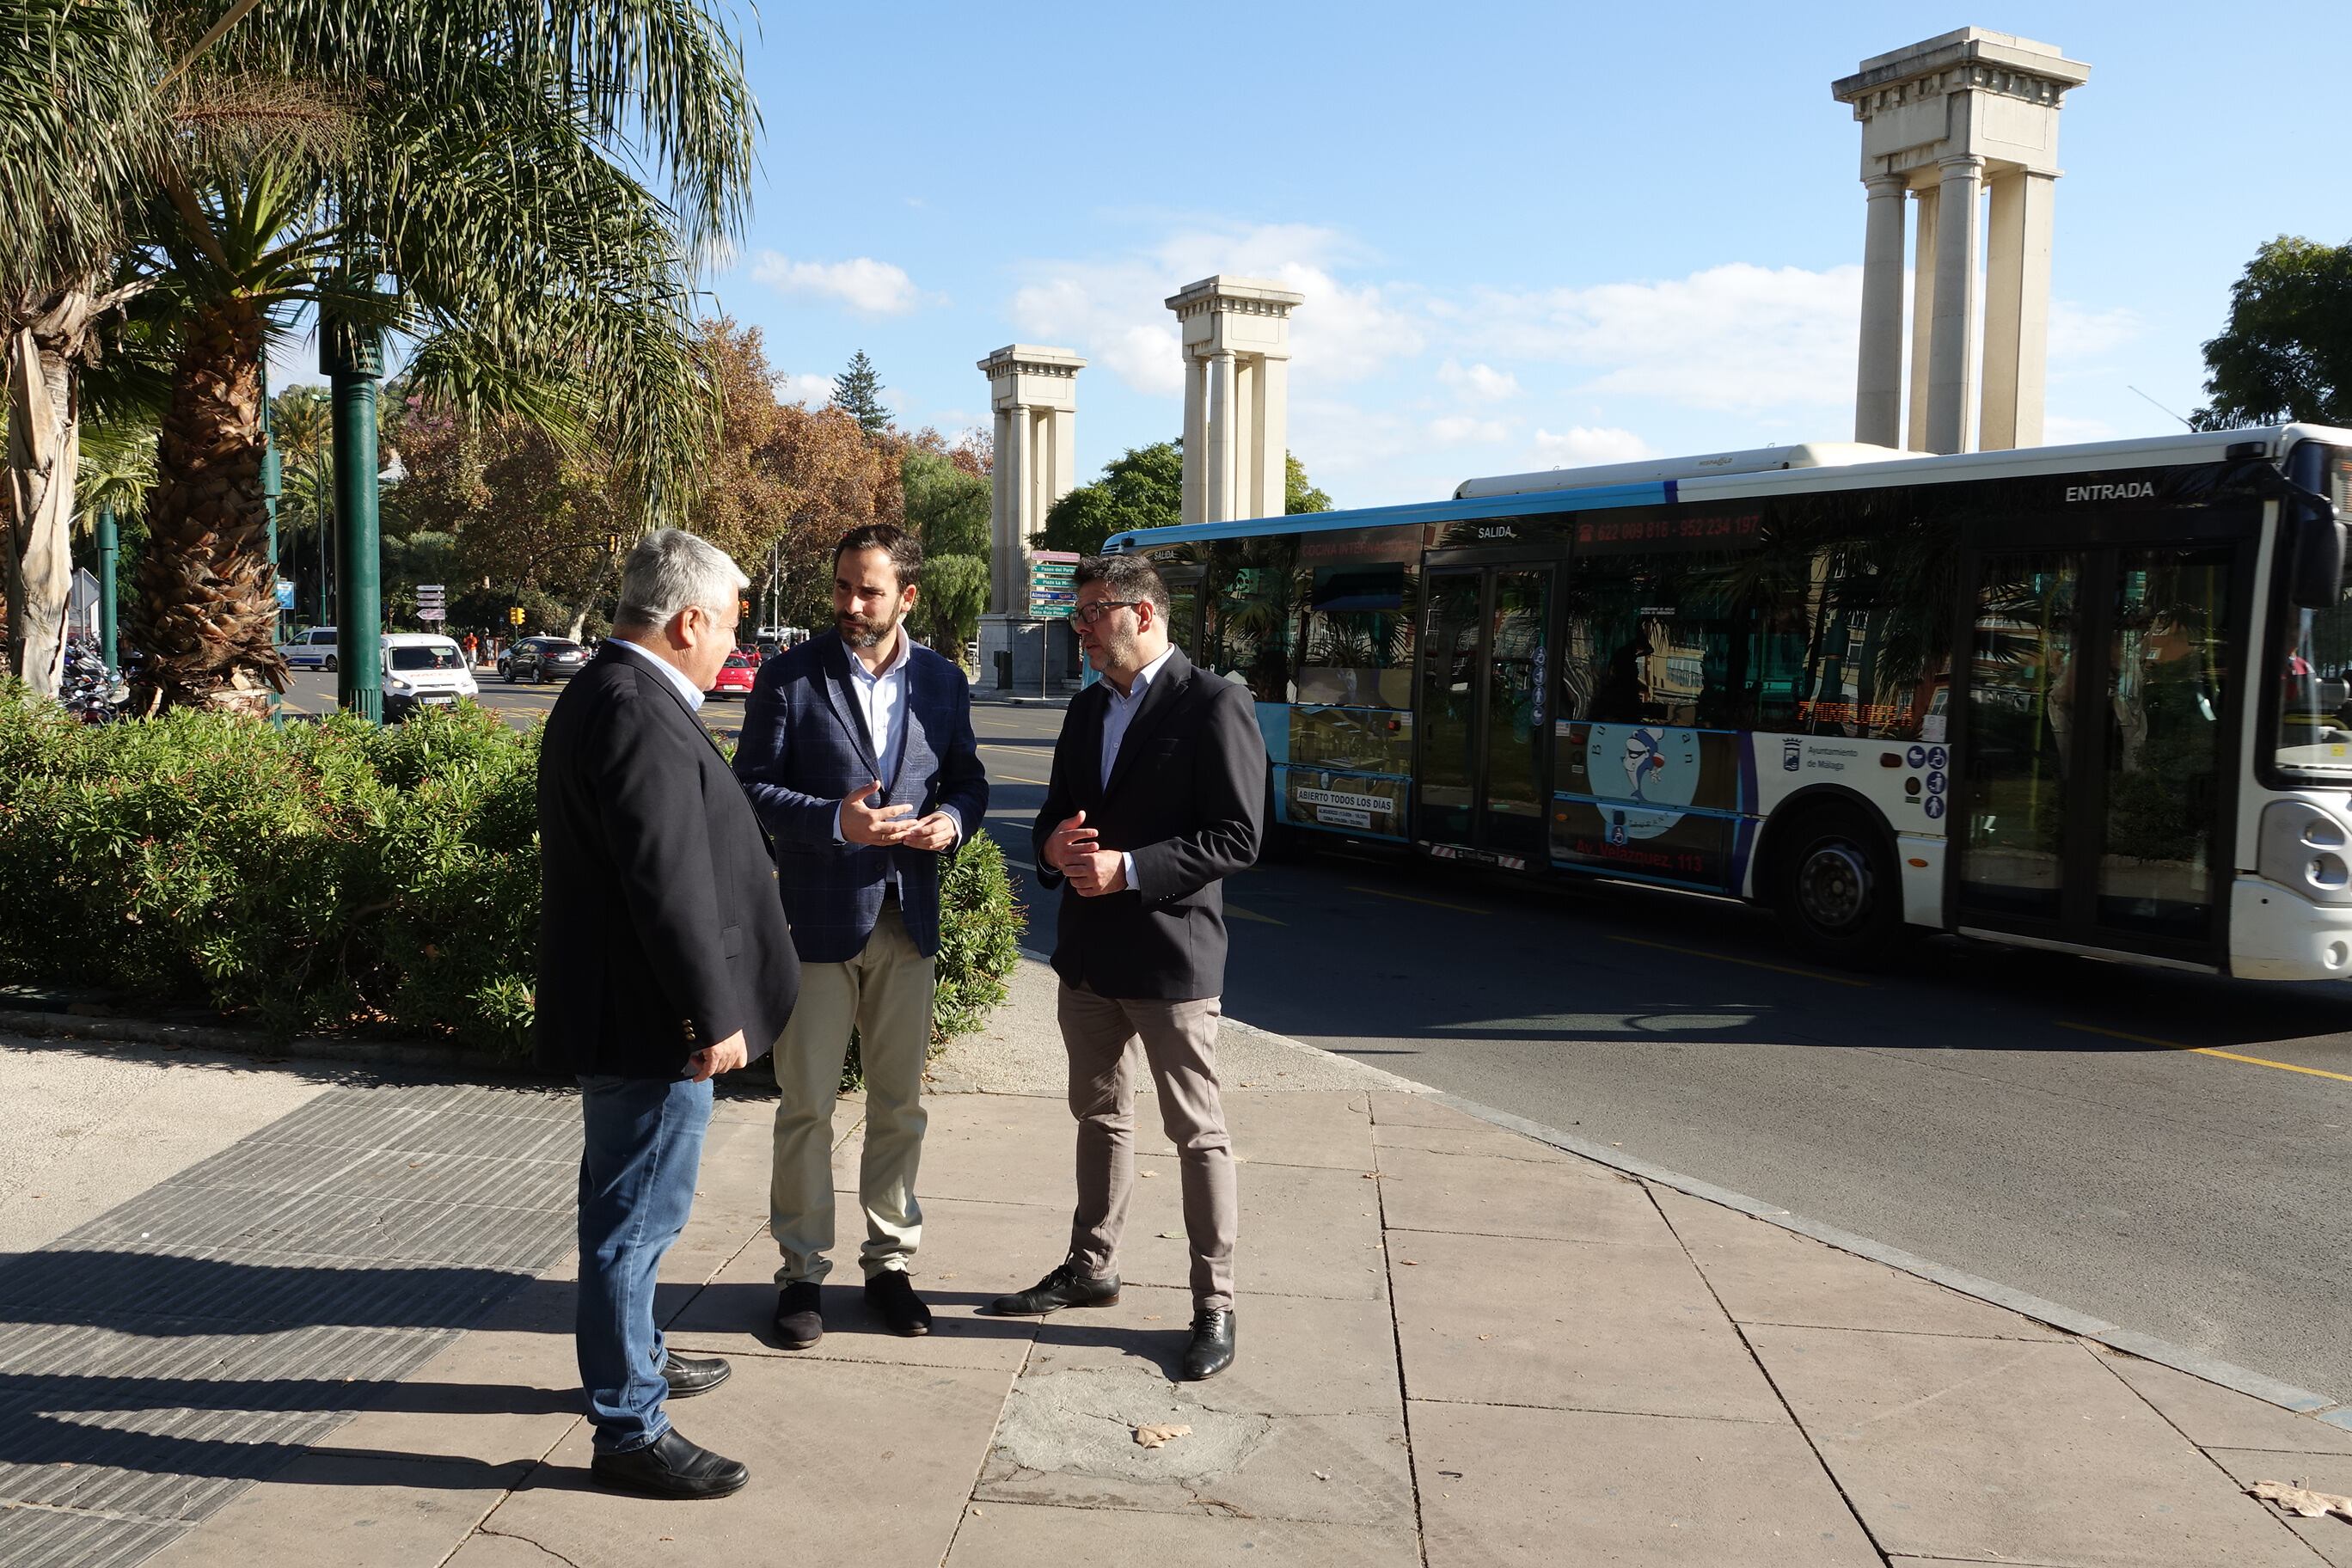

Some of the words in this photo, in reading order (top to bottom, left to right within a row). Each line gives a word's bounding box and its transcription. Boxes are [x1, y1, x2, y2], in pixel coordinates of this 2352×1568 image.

[2065, 481, 2155, 502] ENTRADA
[1478, 525, 1511, 539] SALIDA
[1680, 519, 1703, 537] 952
[1706, 518, 1730, 536] 234
[1736, 515, 1760, 534] 197
[1154, 550, 1174, 560] SALIDA
[1302, 543, 1337, 557] COCINA
[1807, 746, 1859, 757] Ayuntamiento
[1817, 760, 1845, 772] Málaga
[1298, 790, 1329, 803] ABIERTO
[1330, 794, 1356, 806] TODOS
[1357, 798, 1371, 808] LOS
[1677, 853, 1705, 873] 113
